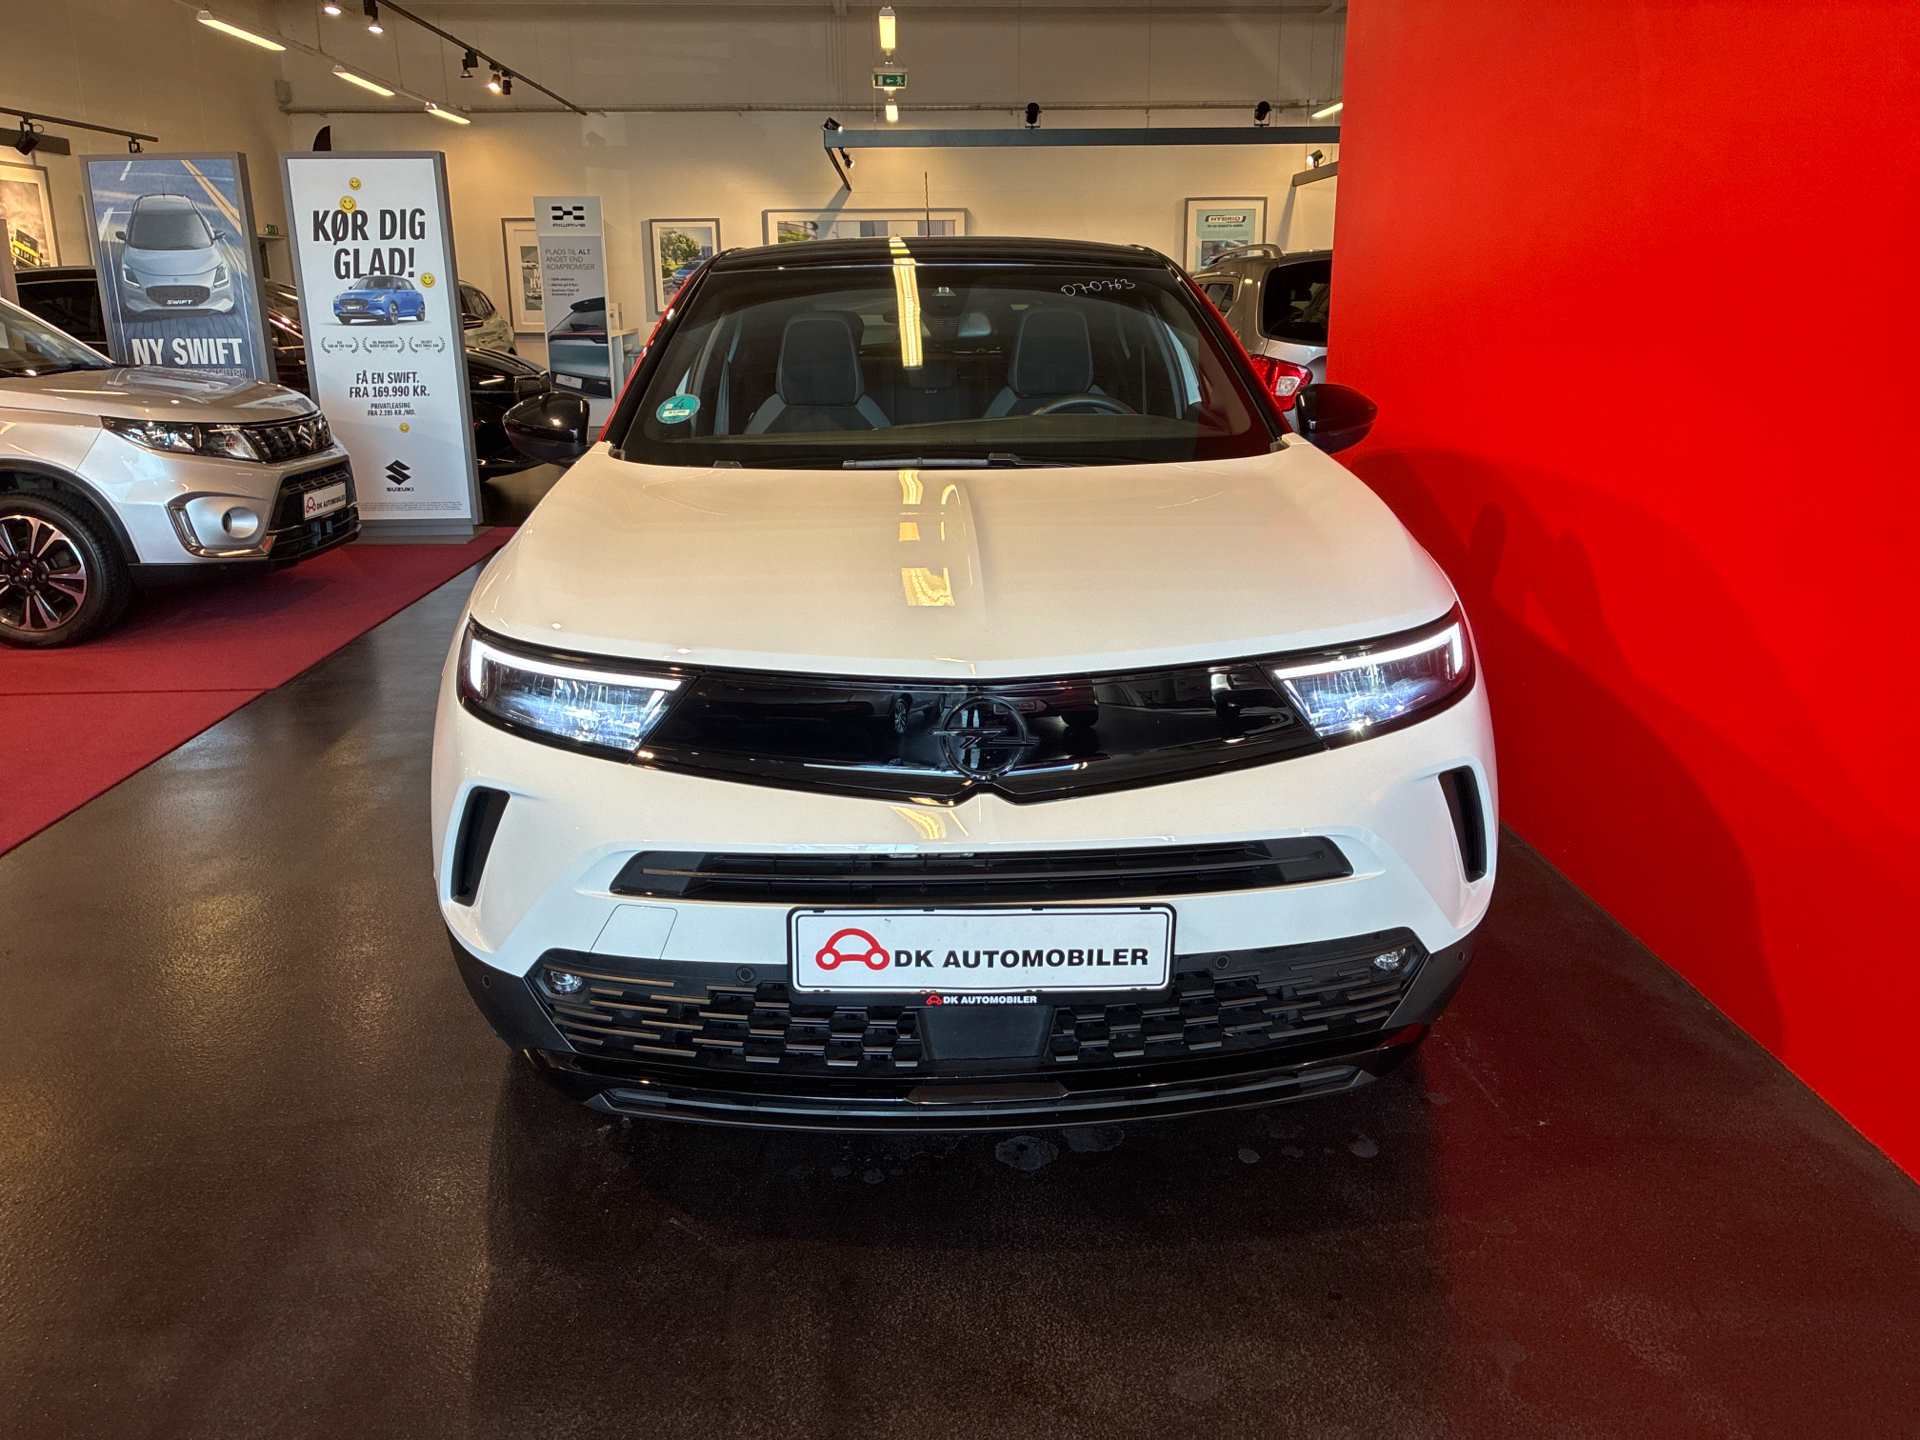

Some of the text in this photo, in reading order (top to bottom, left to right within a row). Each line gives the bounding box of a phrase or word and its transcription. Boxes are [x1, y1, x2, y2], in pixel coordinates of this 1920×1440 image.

[313, 208, 425, 245] KØR DIG
[333, 247, 415, 279] GLAD!
[1060, 278, 1136, 297] 070763
[131, 338, 242, 366] NY SWIFT
[356, 370, 420, 384] FÅ EN SWIFT.
[349, 385, 430, 398] FRA 169.990 KR.
[894, 948, 1149, 968] DK AUTOMOBILER
[943, 995, 1037, 1004] DK AUTOMOBILER
